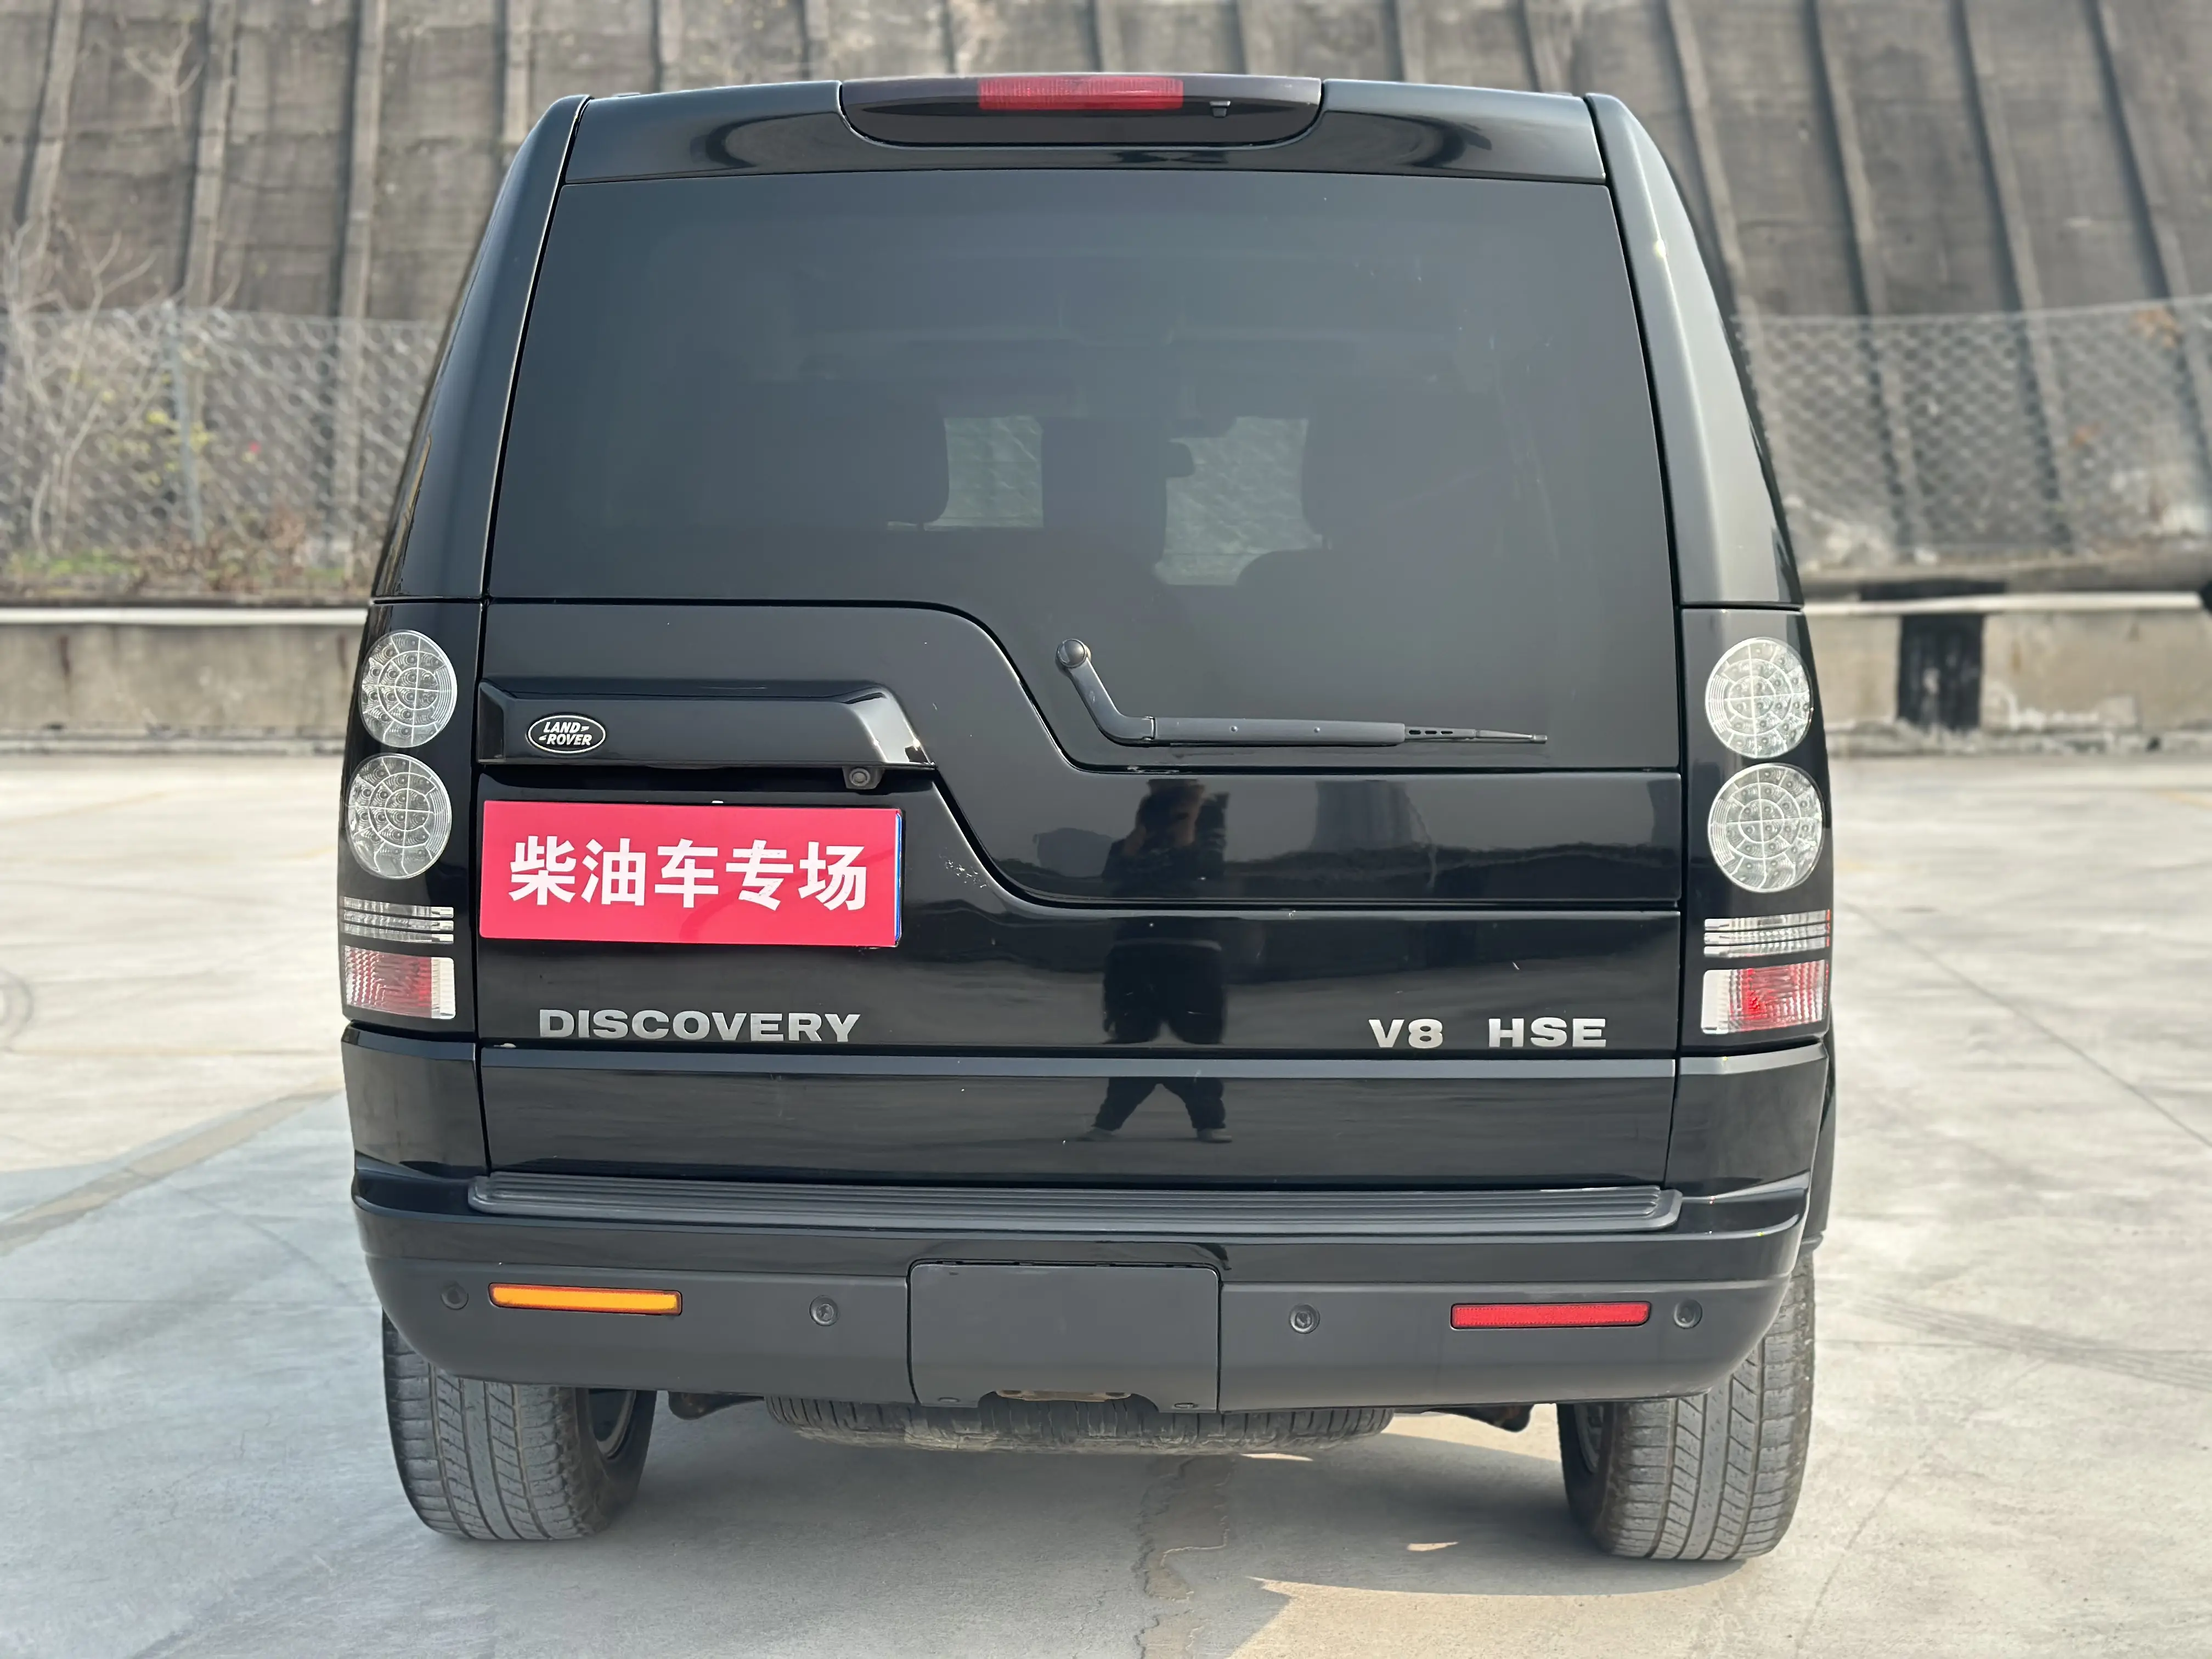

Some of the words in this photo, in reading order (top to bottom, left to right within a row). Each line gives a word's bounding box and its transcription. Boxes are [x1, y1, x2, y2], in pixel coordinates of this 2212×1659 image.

[543, 721, 581, 733] LAND
[546, 733, 592, 746] ROVER
[509, 835, 867, 911] 柴油车专场
[539, 1009, 861, 1042] DISCOVERY
[1368, 1018, 1443, 1049] V8
[1488, 1017, 1607, 1048] HSE
